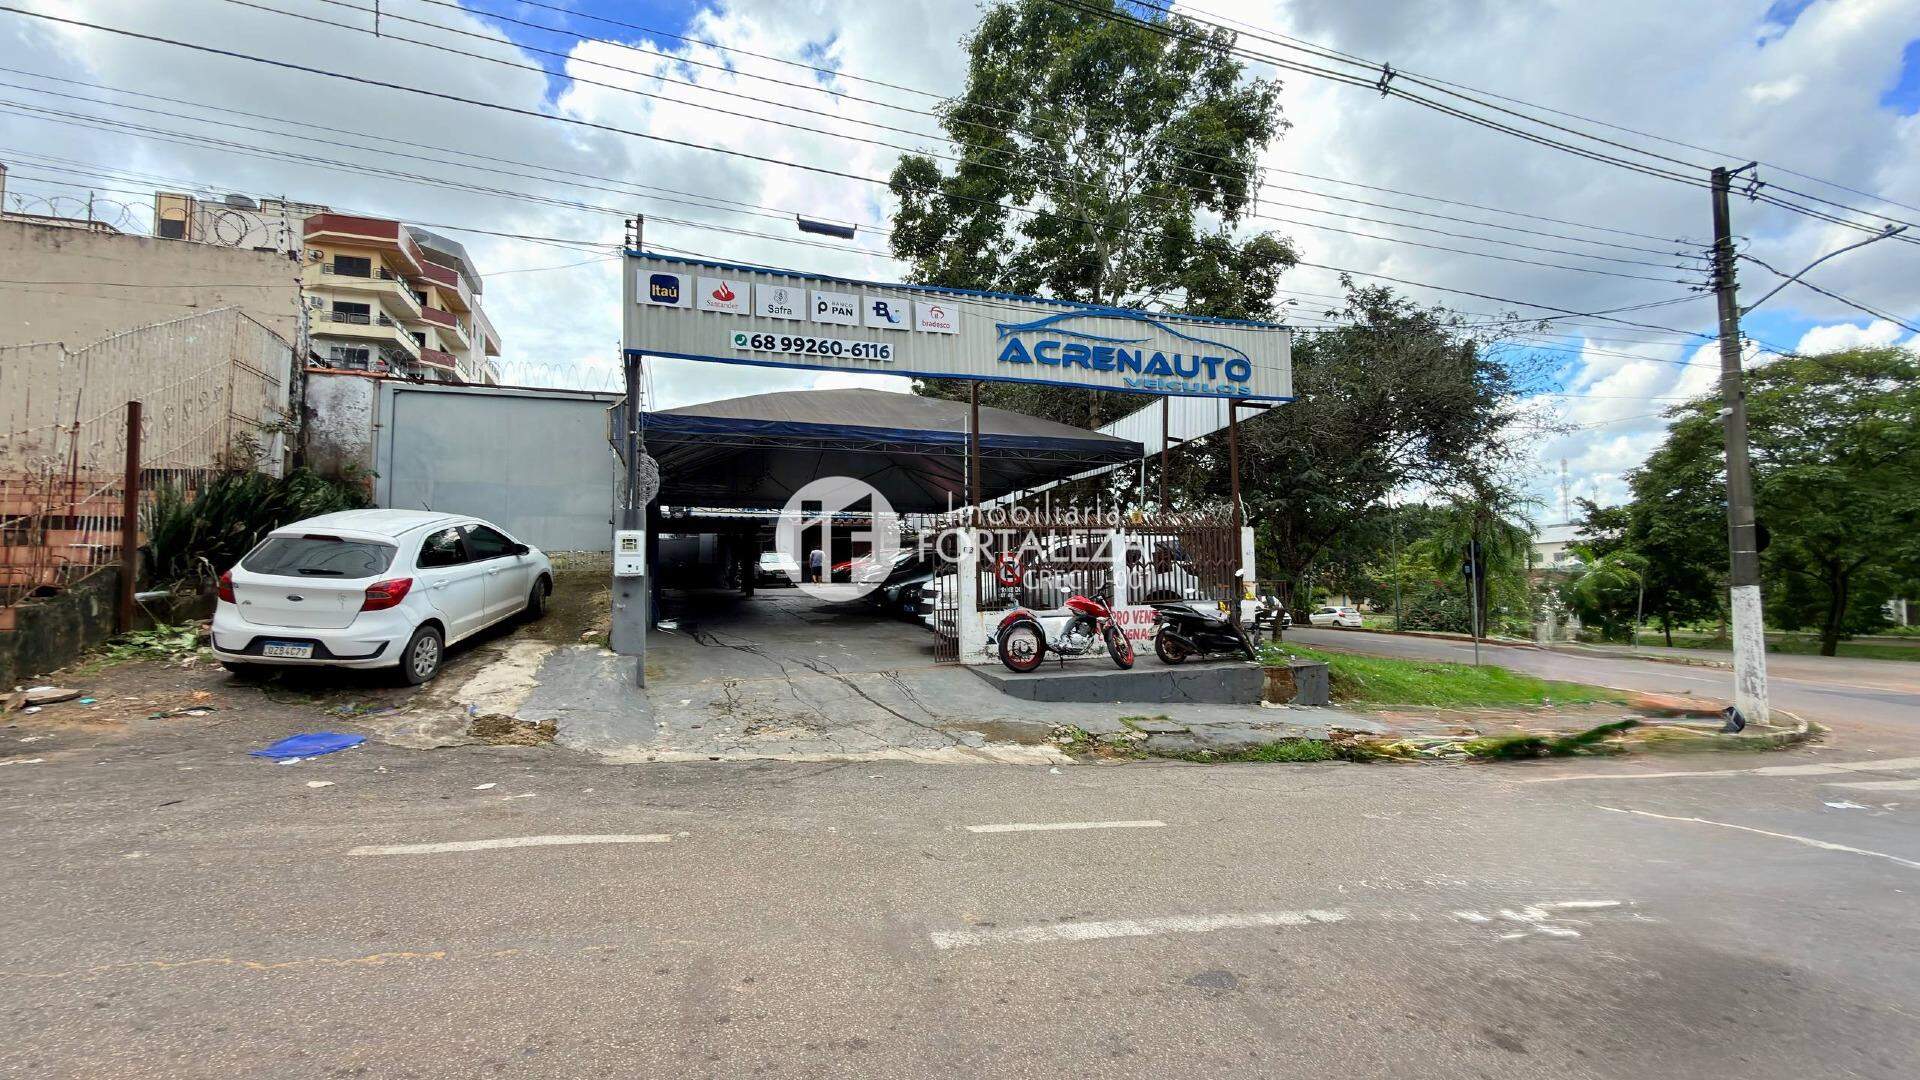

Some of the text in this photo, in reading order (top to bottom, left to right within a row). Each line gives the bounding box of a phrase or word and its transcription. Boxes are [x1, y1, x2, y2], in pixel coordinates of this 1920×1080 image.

[651, 284, 678, 298] Itaú
[706, 299, 739, 310] Santander
[767, 304, 793, 316] Safra
[831, 307, 854, 317] PAN
[921, 319, 951, 330] bradesco
[750, 333, 891, 360] 68 99260-6116
[998, 337, 1252, 383] ACRENAUTO
